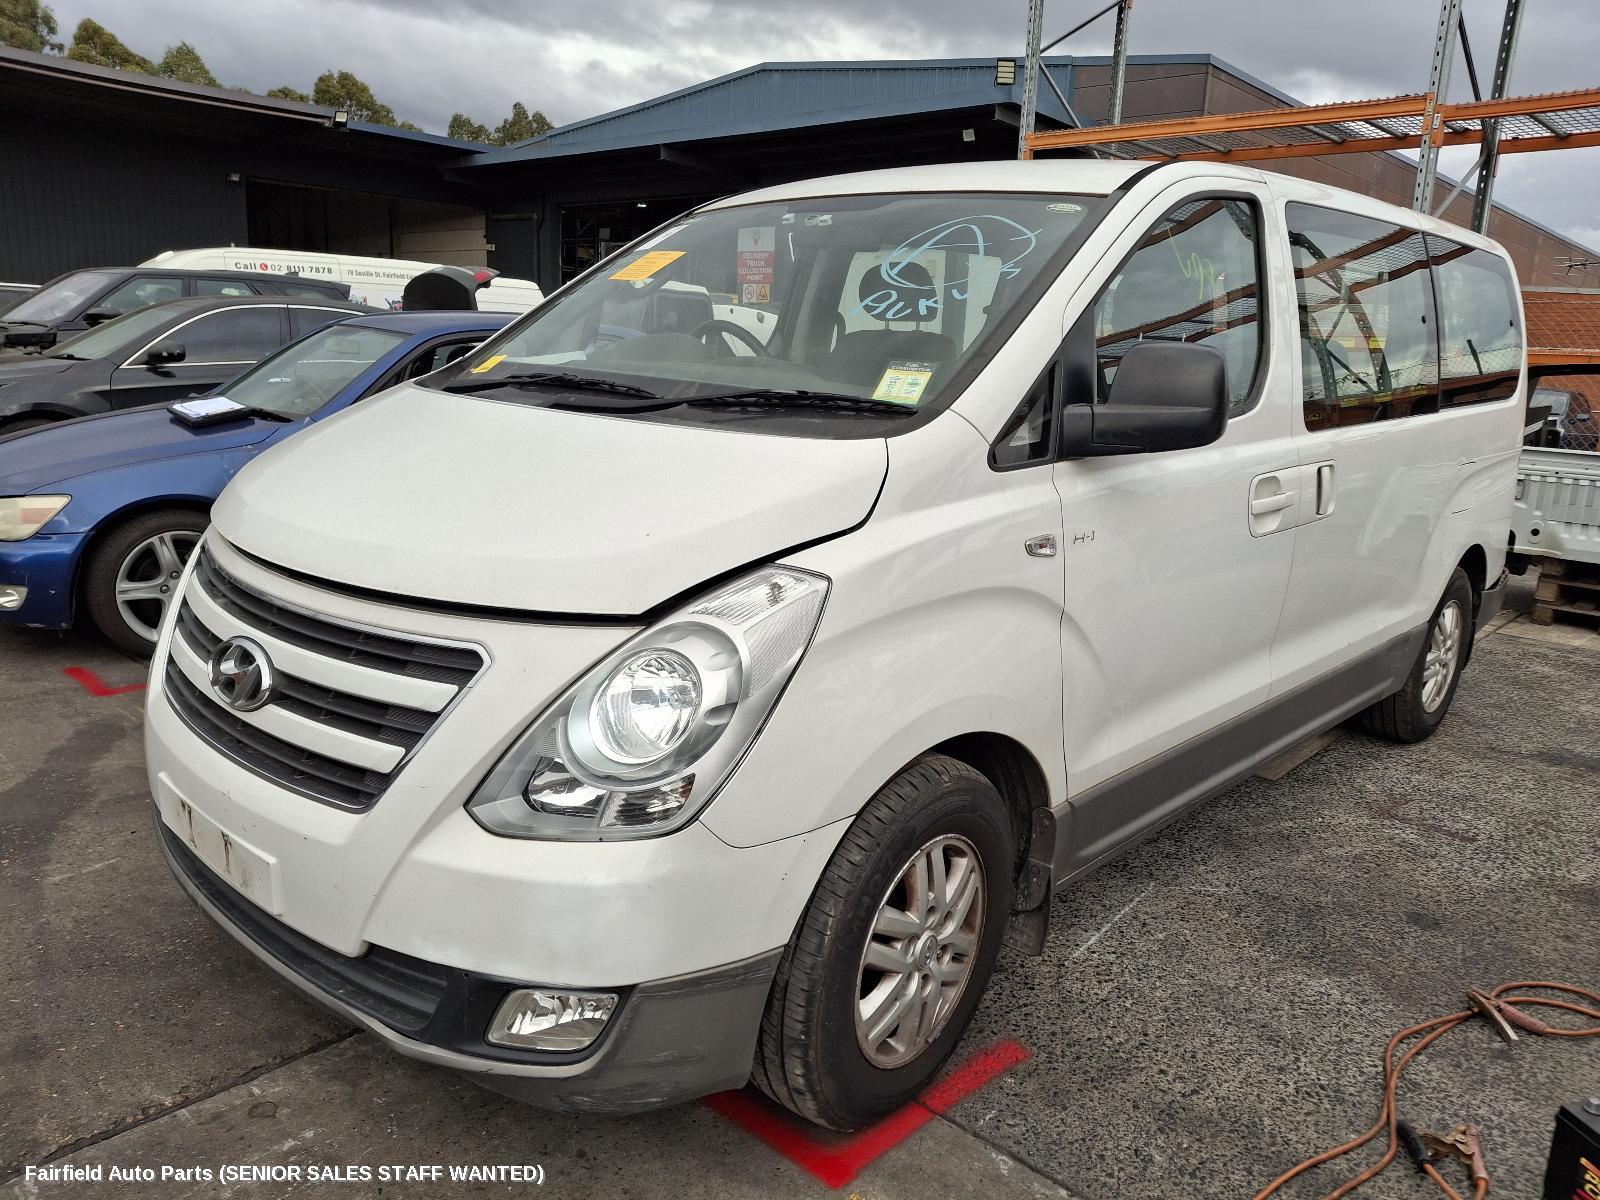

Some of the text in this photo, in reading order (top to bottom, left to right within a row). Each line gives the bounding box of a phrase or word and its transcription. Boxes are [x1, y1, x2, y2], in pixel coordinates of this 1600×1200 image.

[234, 262, 333, 275] Call 02 8111 7878
[382, 272, 405, 280] Fairfield
